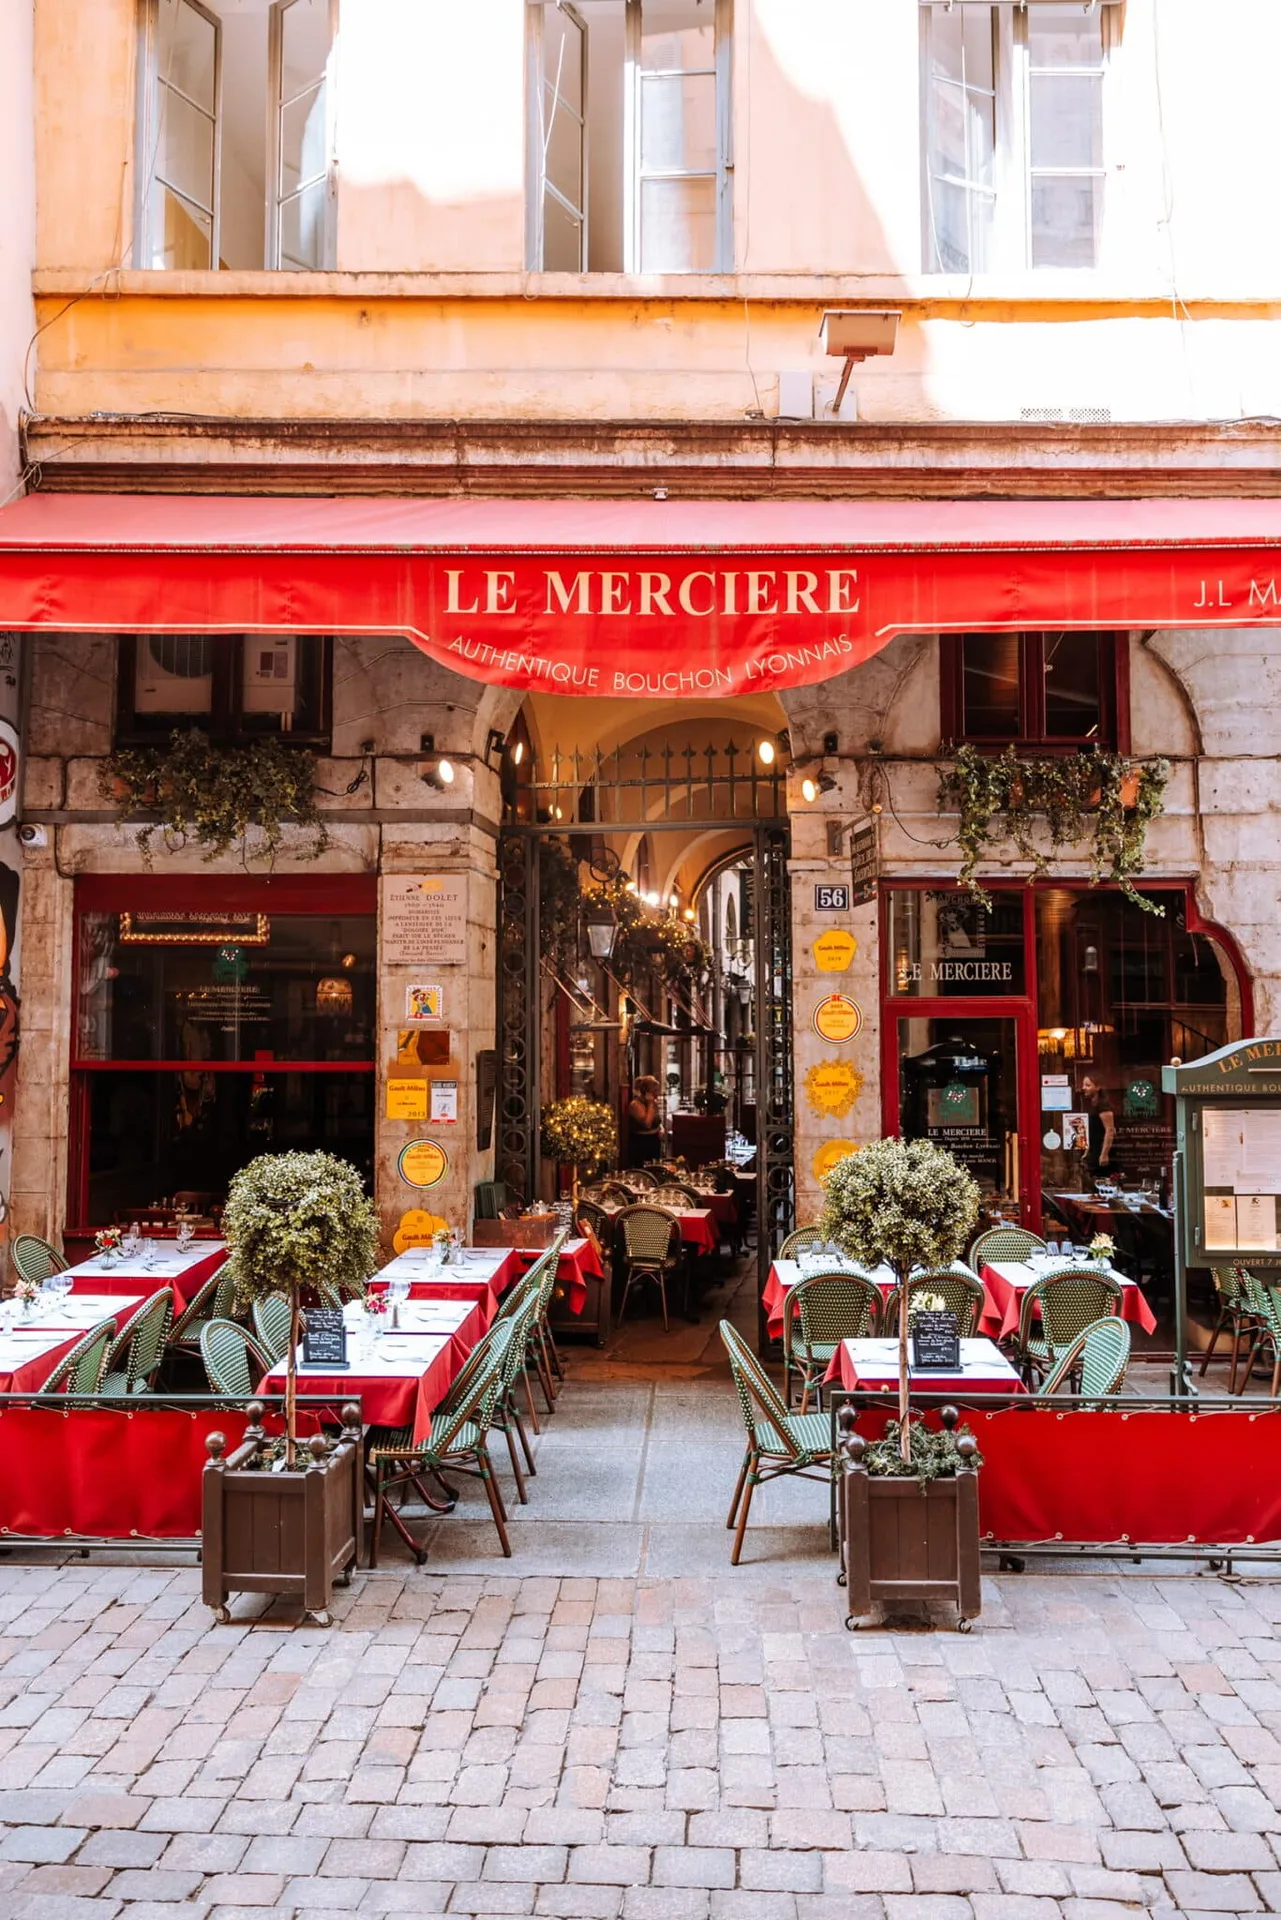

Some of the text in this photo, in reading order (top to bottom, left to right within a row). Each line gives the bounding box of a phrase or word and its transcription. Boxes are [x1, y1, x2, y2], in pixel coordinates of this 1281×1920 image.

[443, 569, 860, 616] LE MERCIERE
[1248, 579, 1281, 605] M
[449, 633, 853, 692] AUTHENTIQUE BOUCHON LYONNAIS
[820, 888, 843, 907] 56
[904, 962, 1012, 981] LE MERCIERE
[1218, 1054, 1242, 1073] LE
[1181, 1084, 1257, 1092] AUTHENTIQUE
[942, 1128, 987, 1136] MERCIERE
[1233, 1258, 1265, 1266] OUVERT
